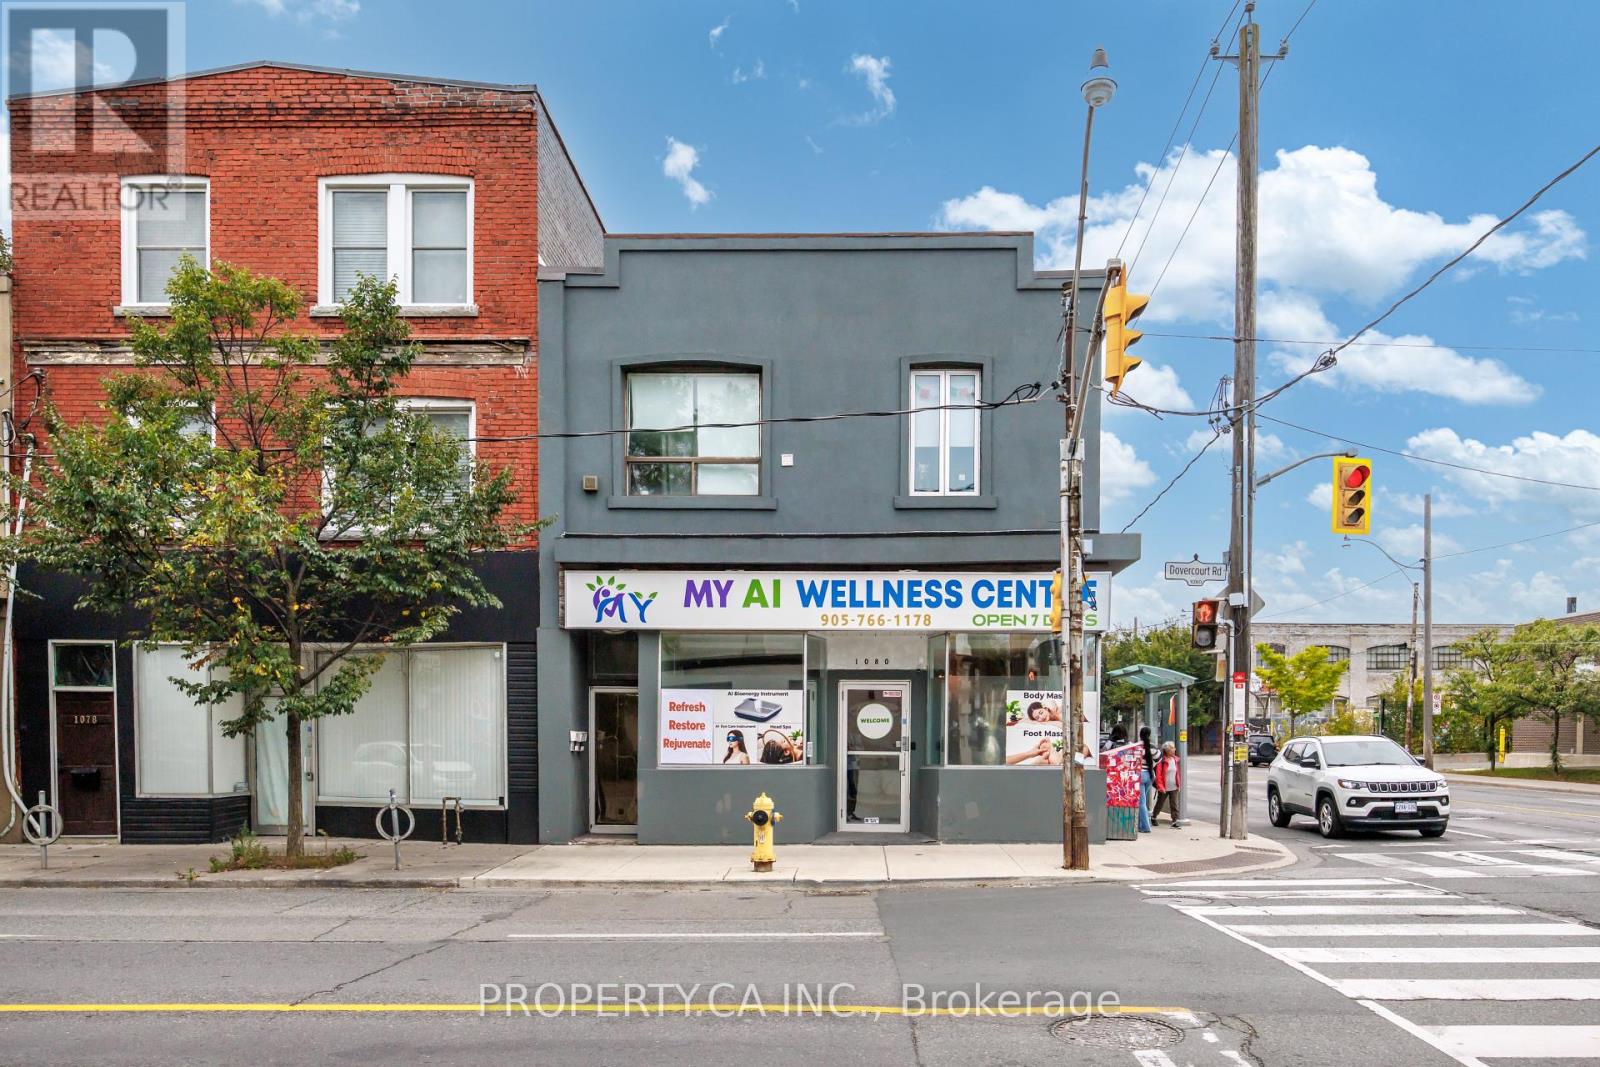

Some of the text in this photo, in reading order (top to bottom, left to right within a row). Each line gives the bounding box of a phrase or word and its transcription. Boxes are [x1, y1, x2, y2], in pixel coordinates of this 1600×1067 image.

[1169, 565, 1222, 576] Dovercourt Rd
[684, 579, 1098, 609] MY AI WELLNESS CENTE
[821, 614, 932, 627] 905-766-1178
[972, 614, 1097, 627] OPEN 7 DS
[1024, 692, 1044, 700] Body
[669, 701, 706, 713] Refresh
[74, 715, 98, 724] 1078
[669, 720, 706, 732] Restore
[1023, 729, 1042, 737] Foot
[663, 738, 711, 752] Rejuvenate
